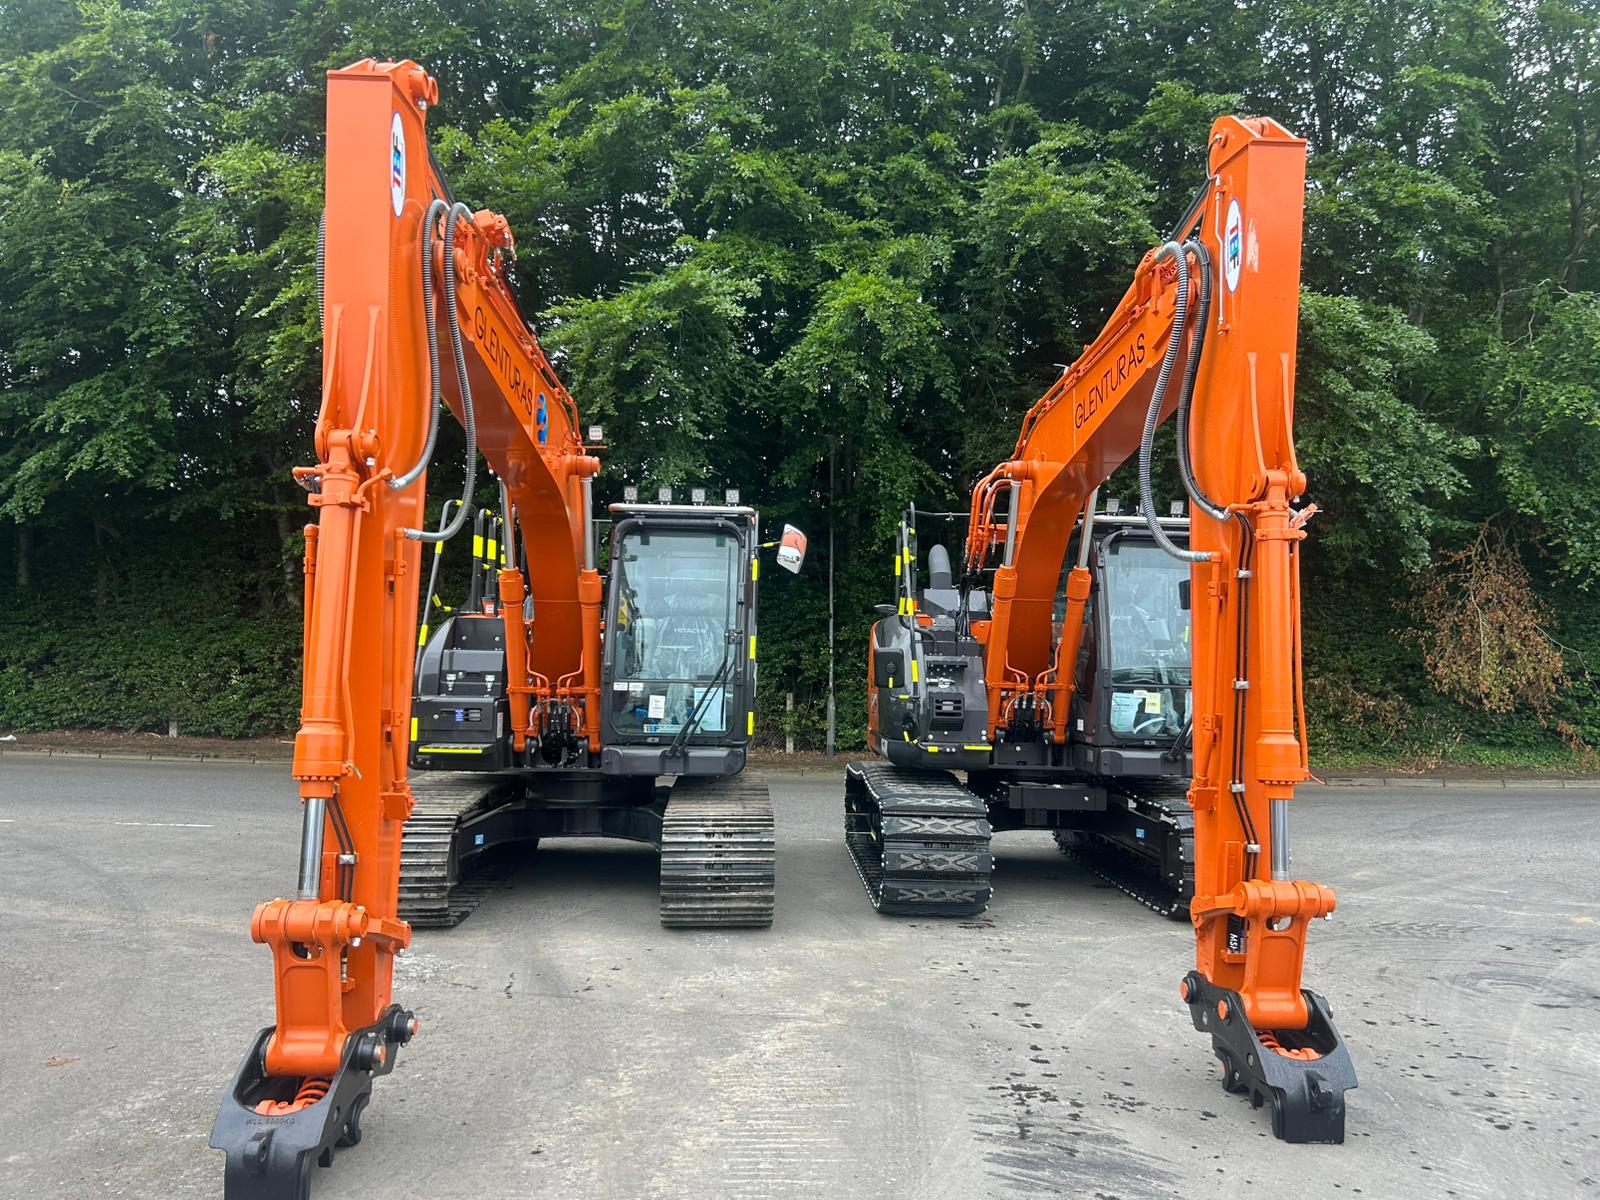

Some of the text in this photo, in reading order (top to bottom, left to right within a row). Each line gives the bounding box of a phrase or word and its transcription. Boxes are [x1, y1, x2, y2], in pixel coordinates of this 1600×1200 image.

[1229, 216, 1240, 269] TBF
[474, 305, 534, 417] GLENTURAS
[1075, 332, 1146, 429] GLENTURAS
[245, 1117, 263, 1125] WLL
